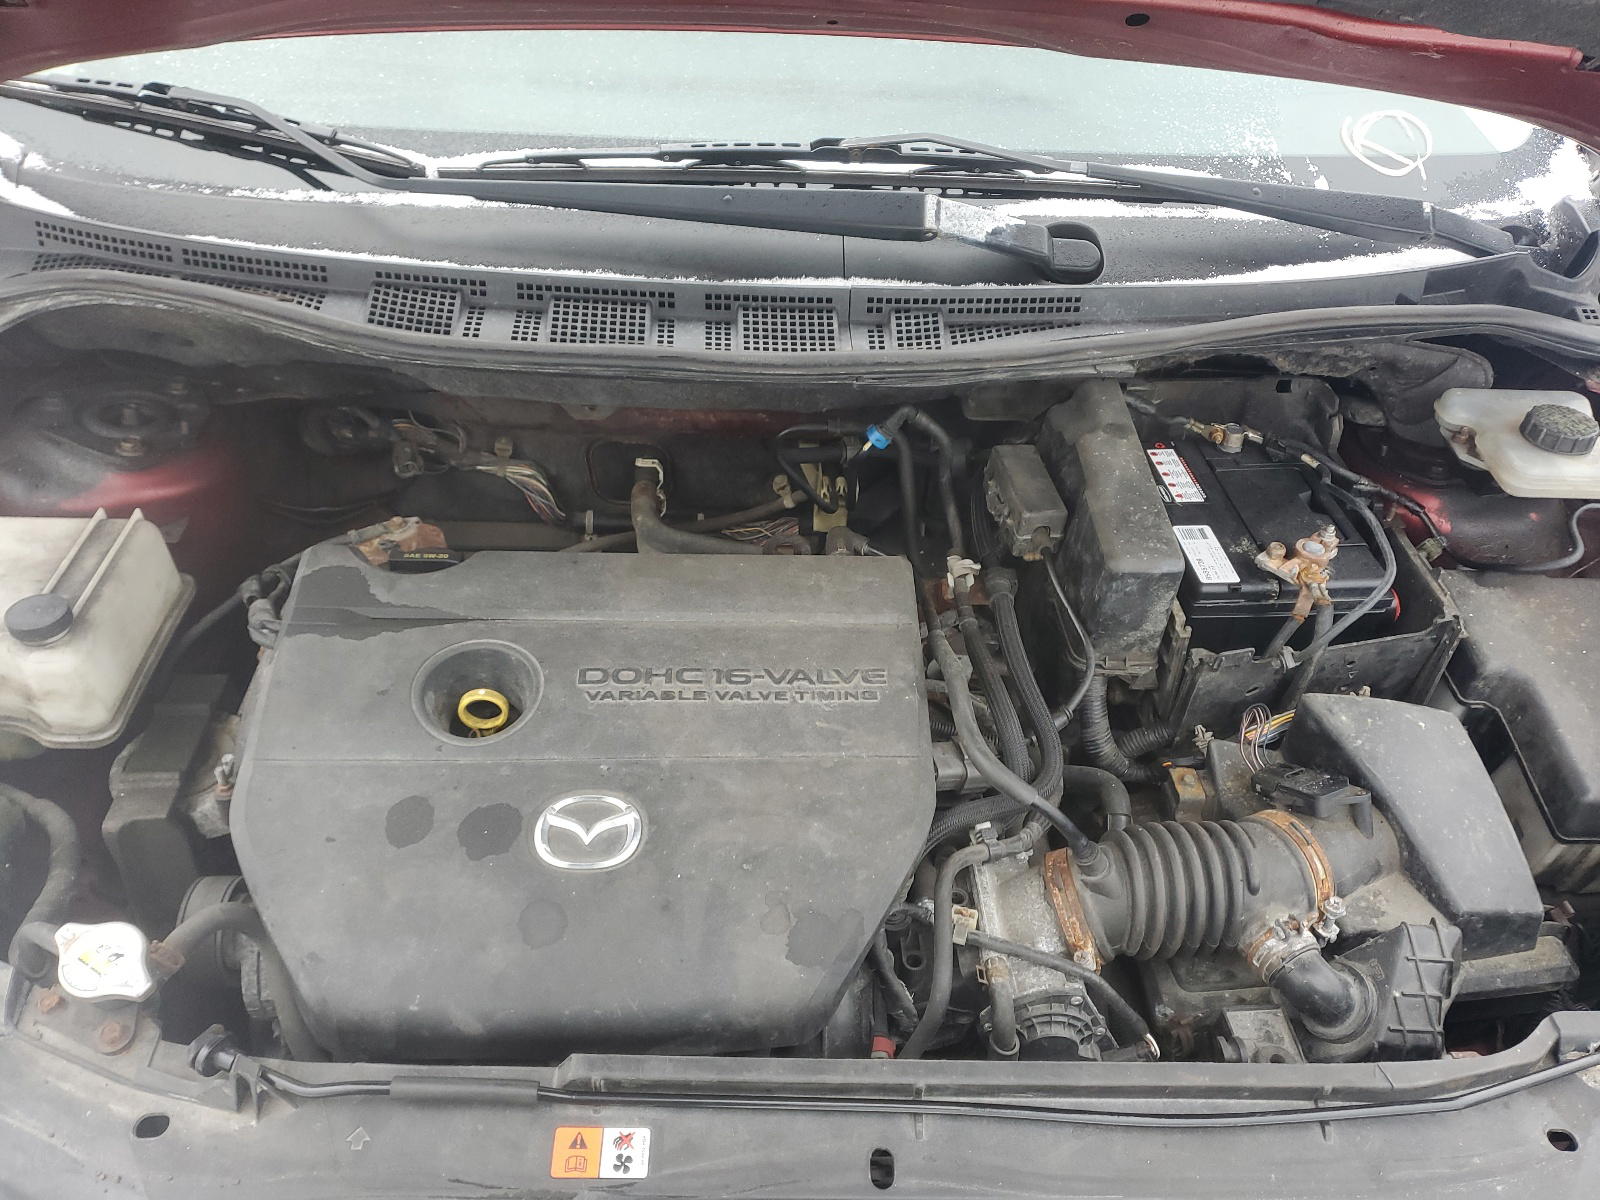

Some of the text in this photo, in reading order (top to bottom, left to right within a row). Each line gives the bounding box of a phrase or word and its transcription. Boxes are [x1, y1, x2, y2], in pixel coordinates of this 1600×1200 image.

[577, 667, 887, 686] DOHC 16-VALVE
[585, 690, 879, 701] VARIABLE VALVE TIMING
